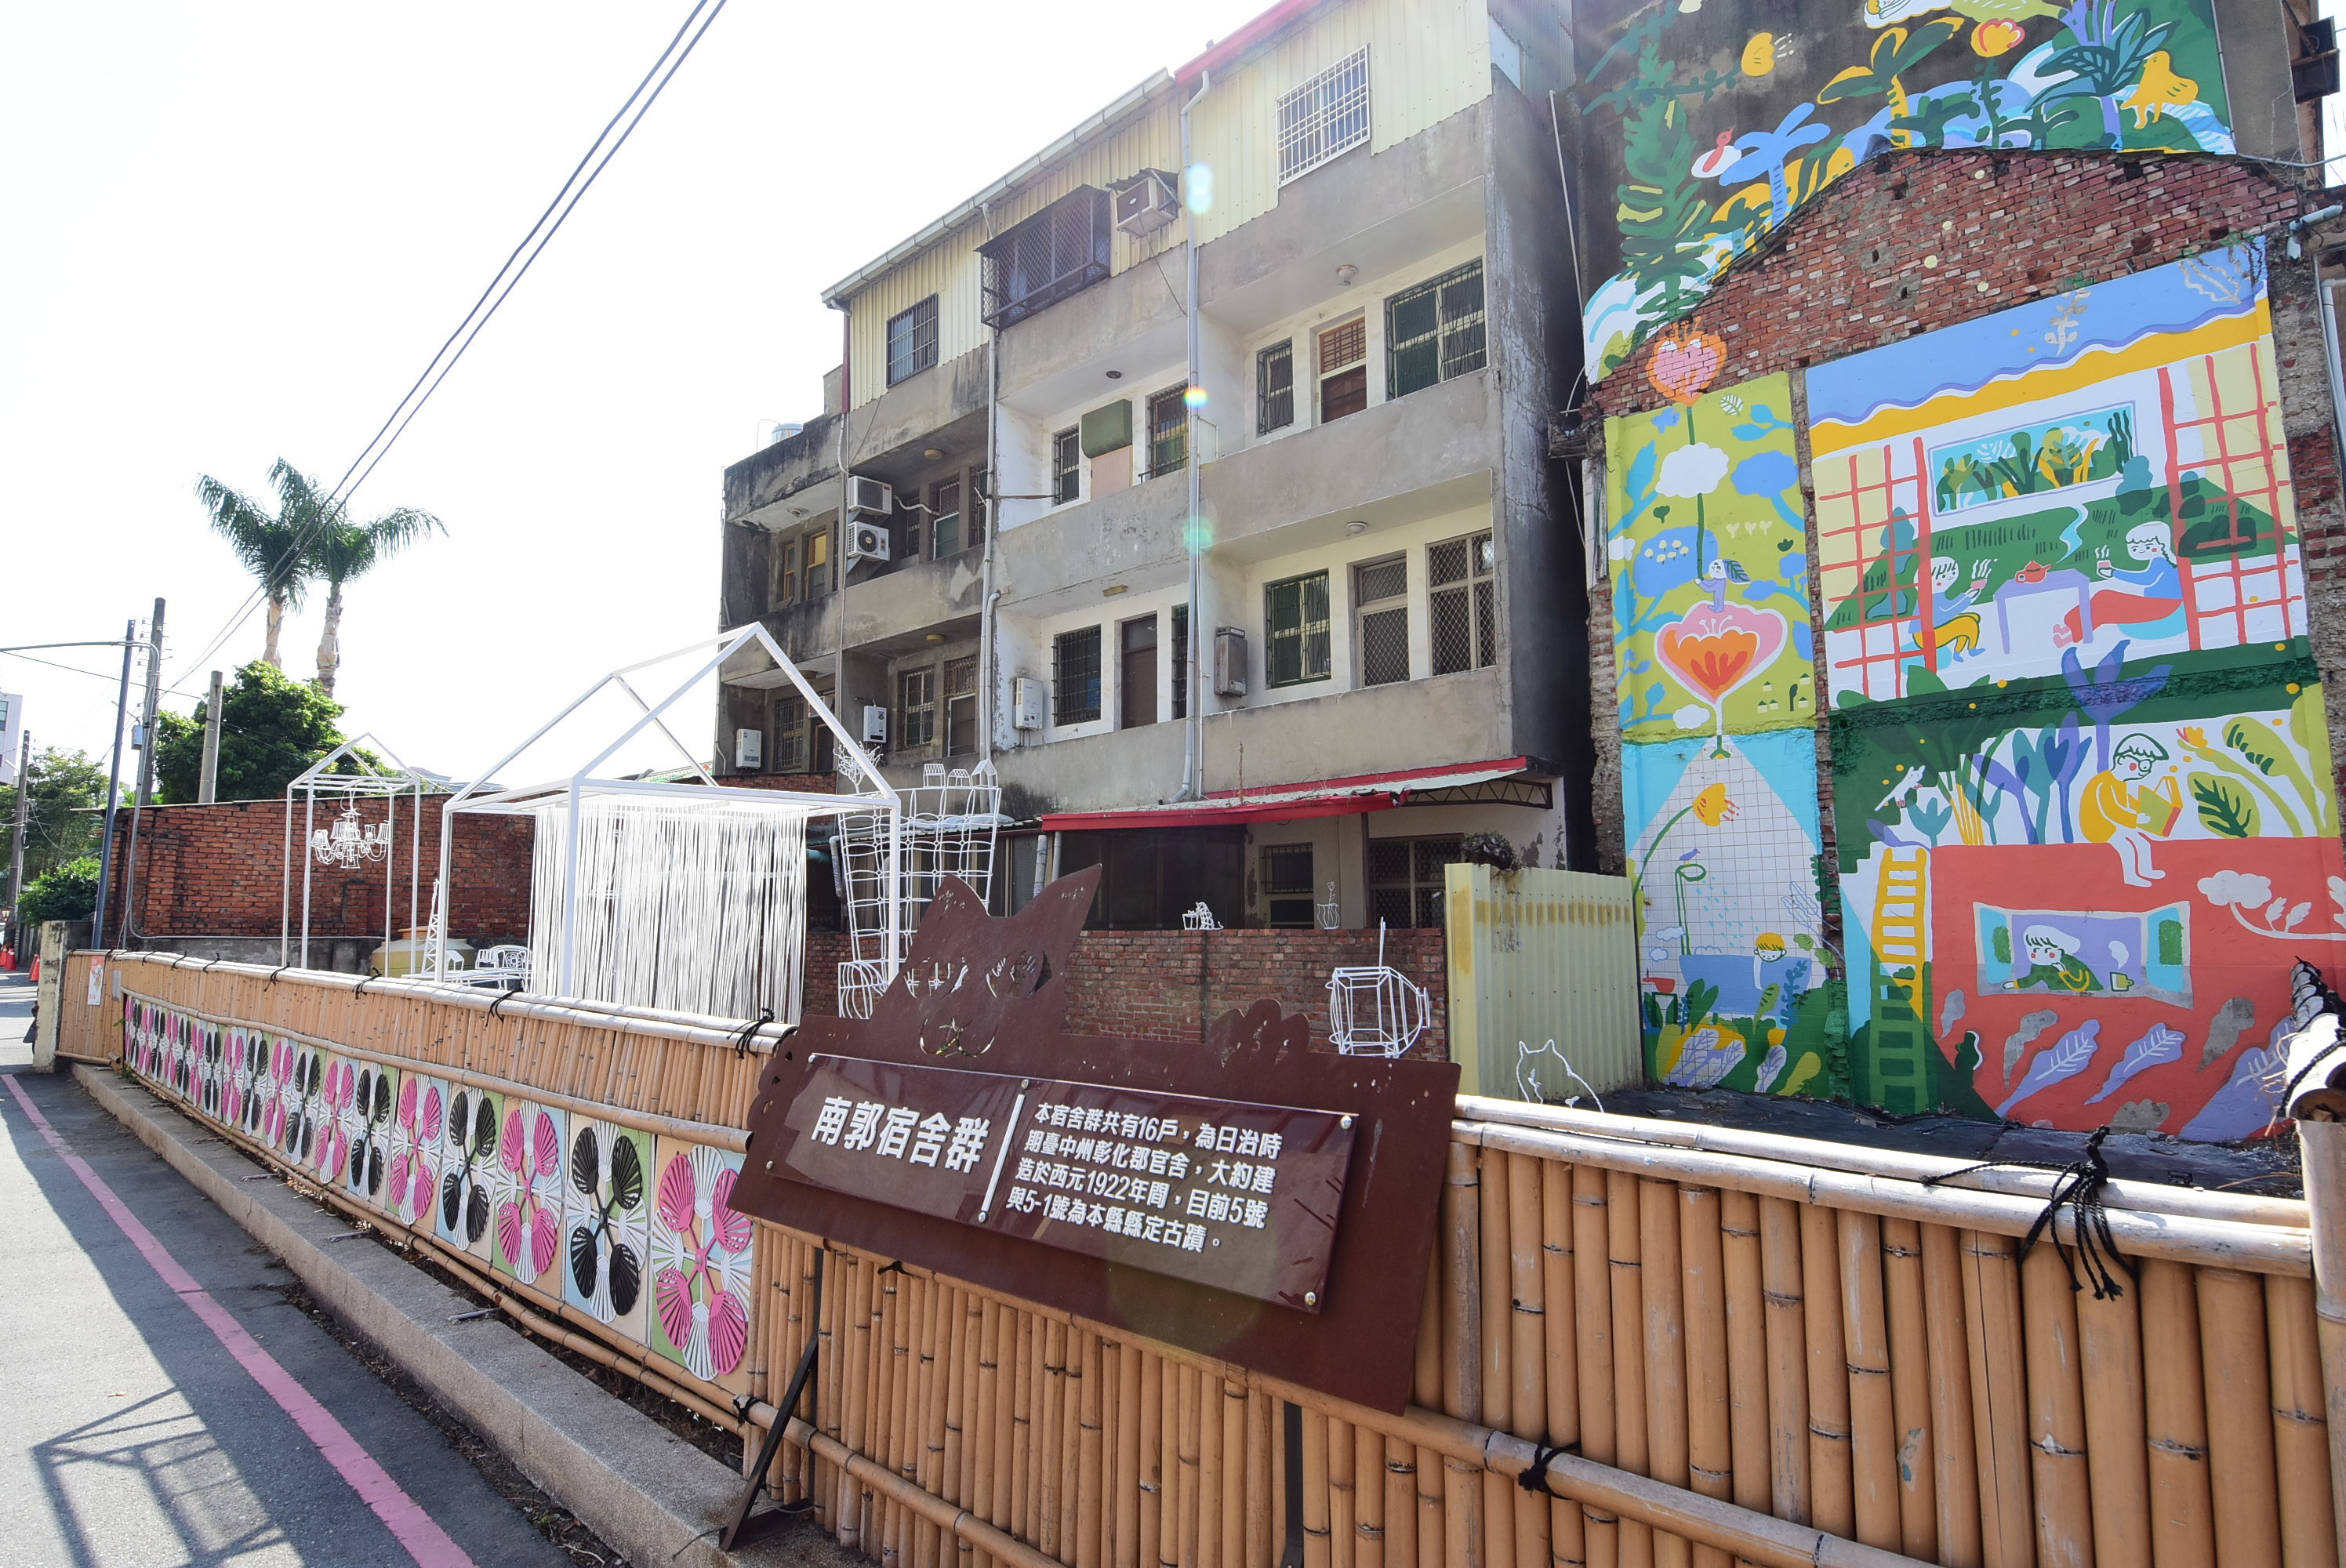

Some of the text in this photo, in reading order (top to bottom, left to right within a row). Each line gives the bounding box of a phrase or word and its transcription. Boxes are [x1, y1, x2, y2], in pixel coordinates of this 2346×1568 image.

[811, 1096, 990, 1174] 南郭宿舍群
